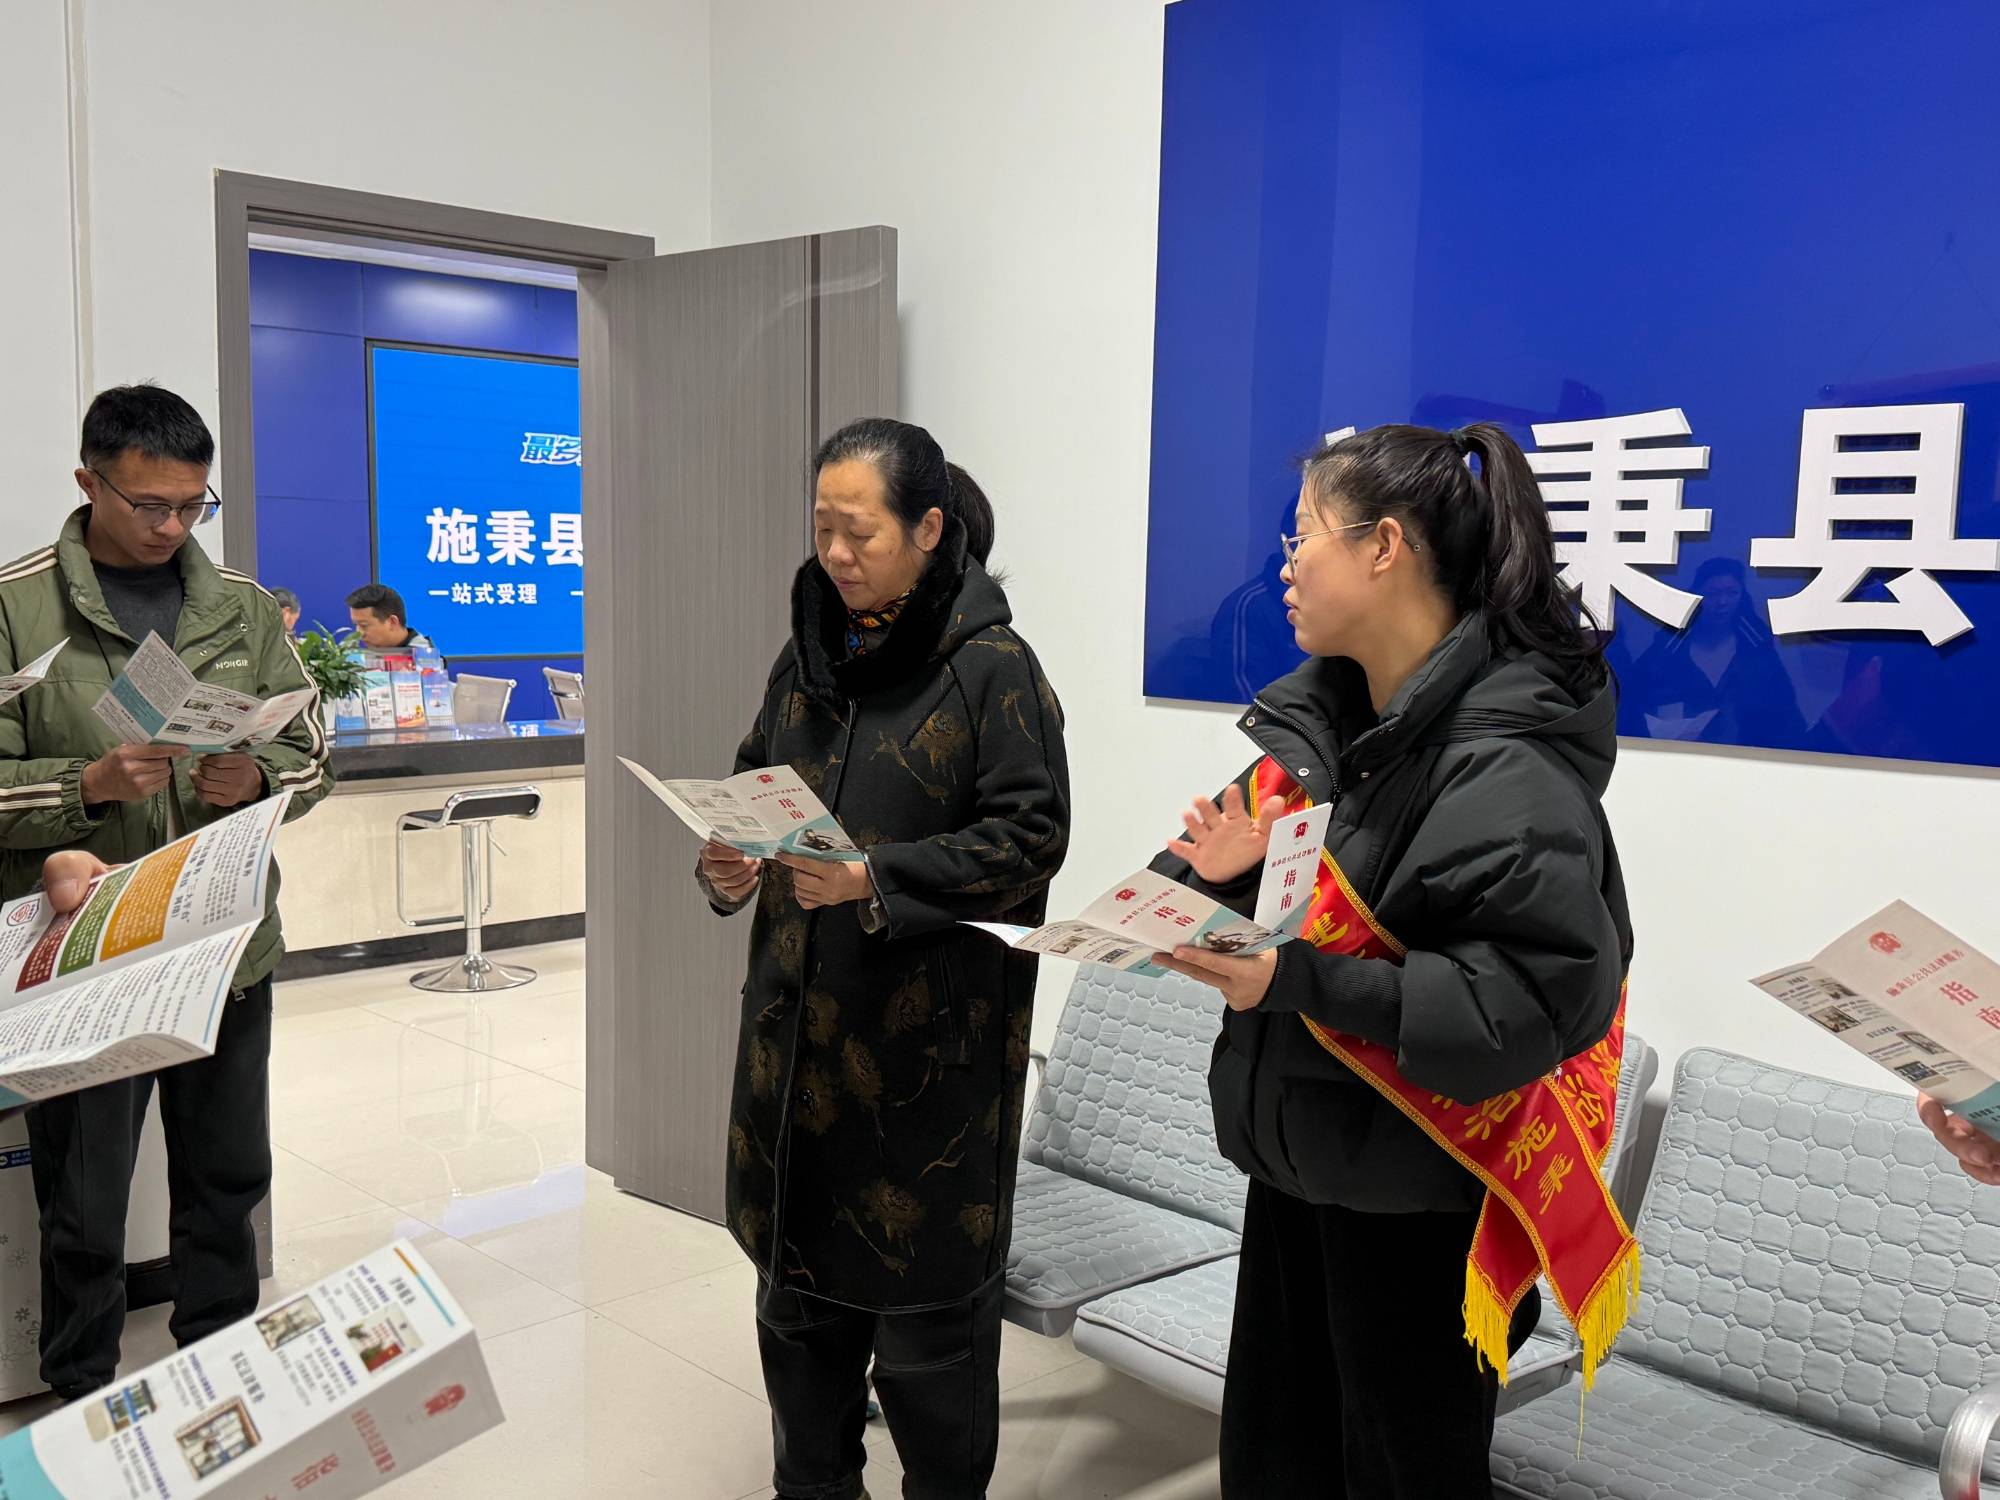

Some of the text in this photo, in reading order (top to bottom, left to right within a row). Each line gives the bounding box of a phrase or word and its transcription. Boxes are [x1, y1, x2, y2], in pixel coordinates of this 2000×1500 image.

[426, 507, 583, 567] 施秉县
[1324, 403, 2000, 648] 秉县
[428, 582, 538, 605] 一站式受理
[1281, 869, 1297, 911] 指南
[1153, 905, 1195, 927] 指南
